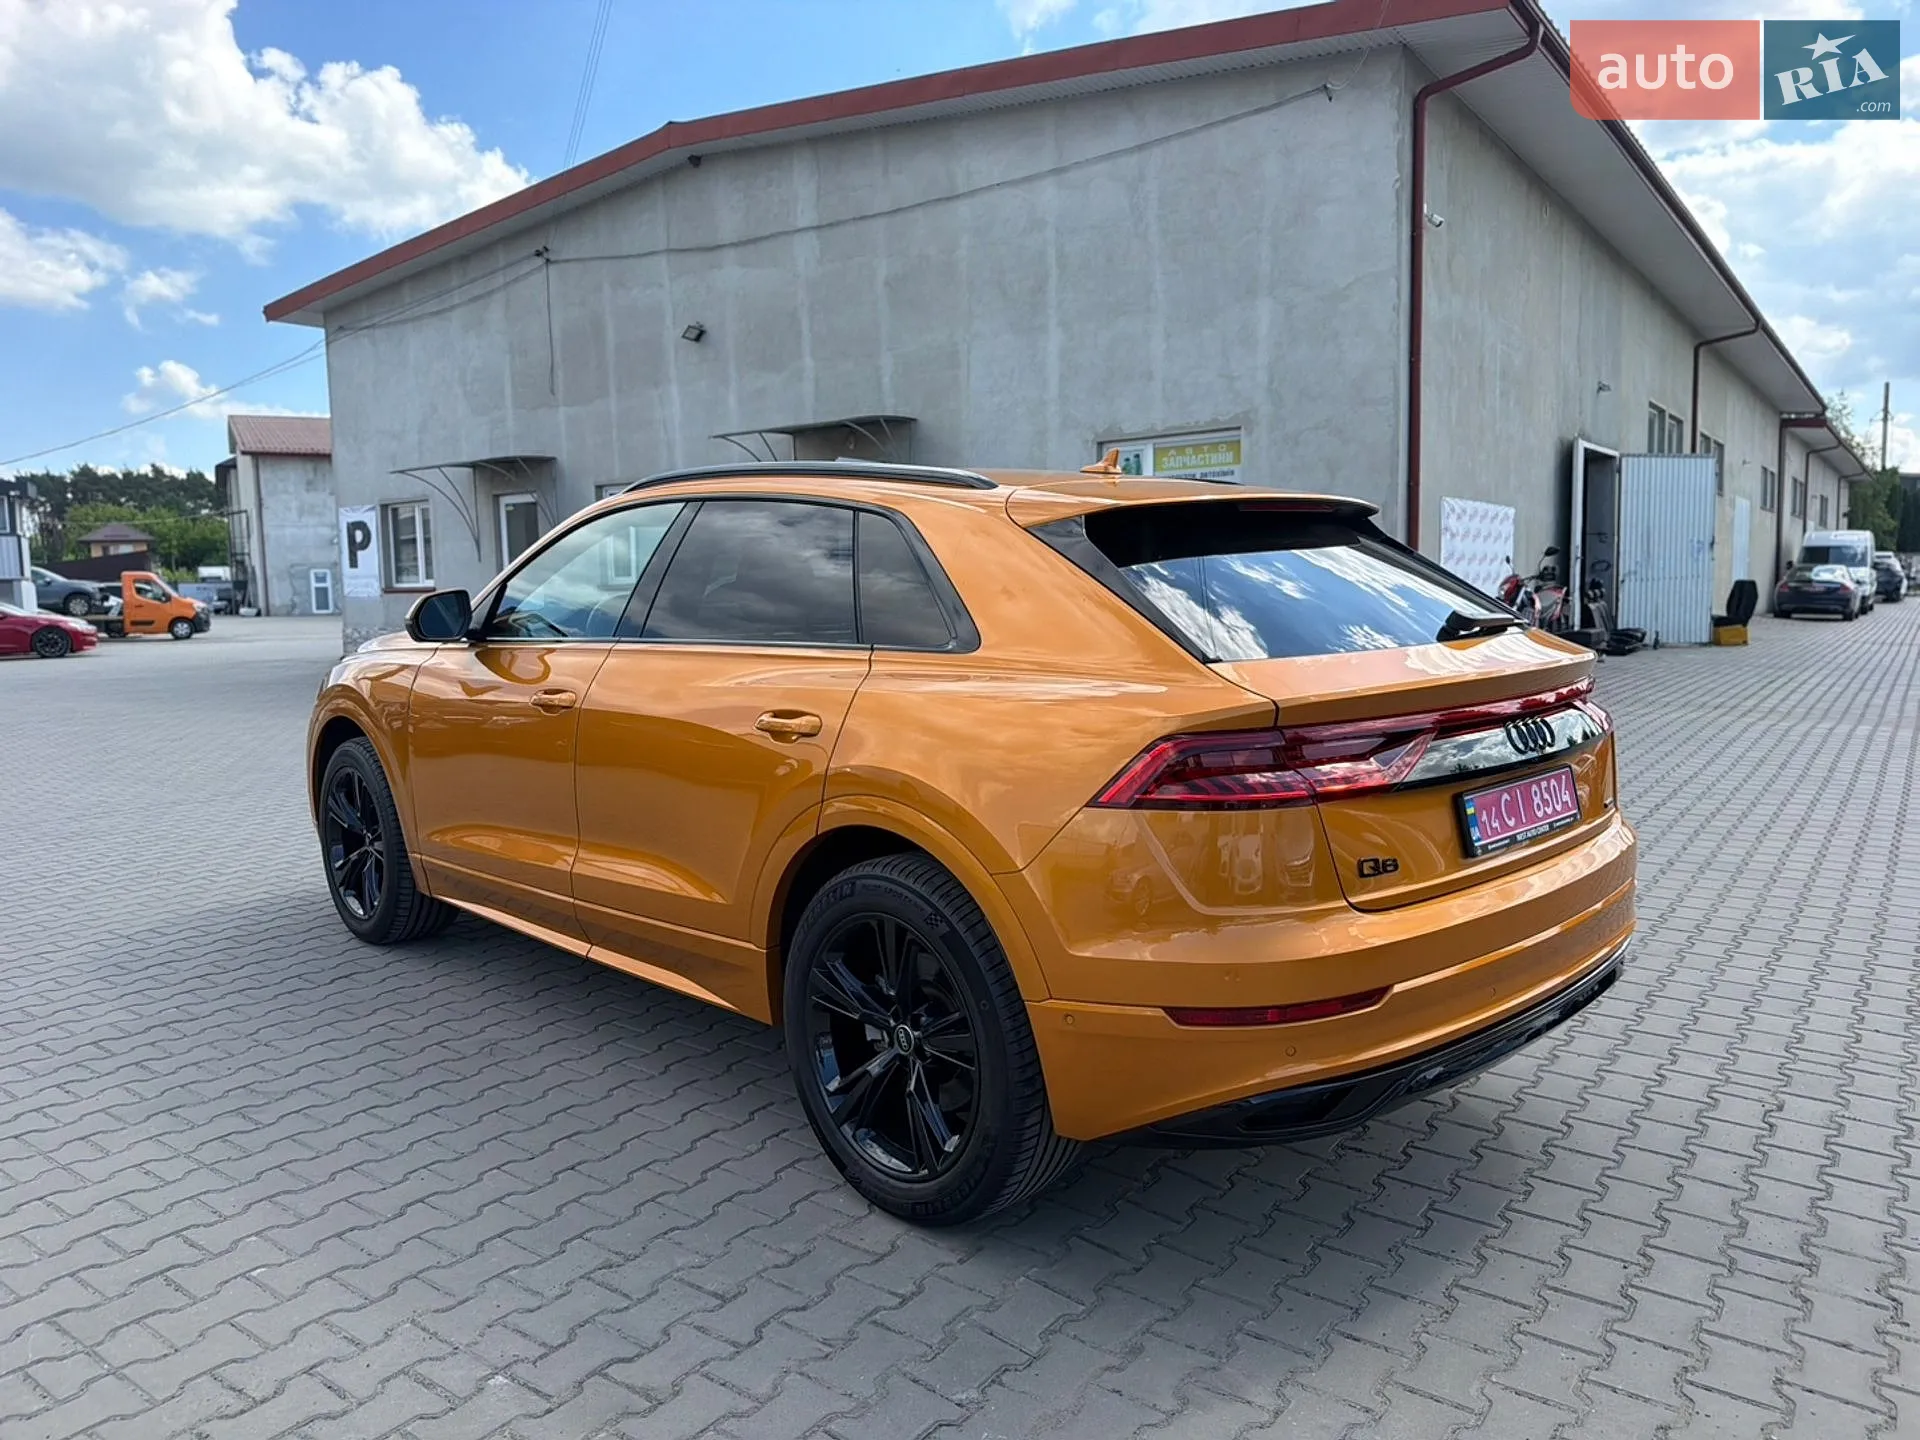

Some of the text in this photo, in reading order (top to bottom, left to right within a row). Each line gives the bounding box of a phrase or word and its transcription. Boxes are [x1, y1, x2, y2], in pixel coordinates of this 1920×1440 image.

[1162, 451, 1234, 468] ЗАПЧАСТИНИ
[346, 520, 372, 569] P
[1531, 775, 1572, 818] 8504
